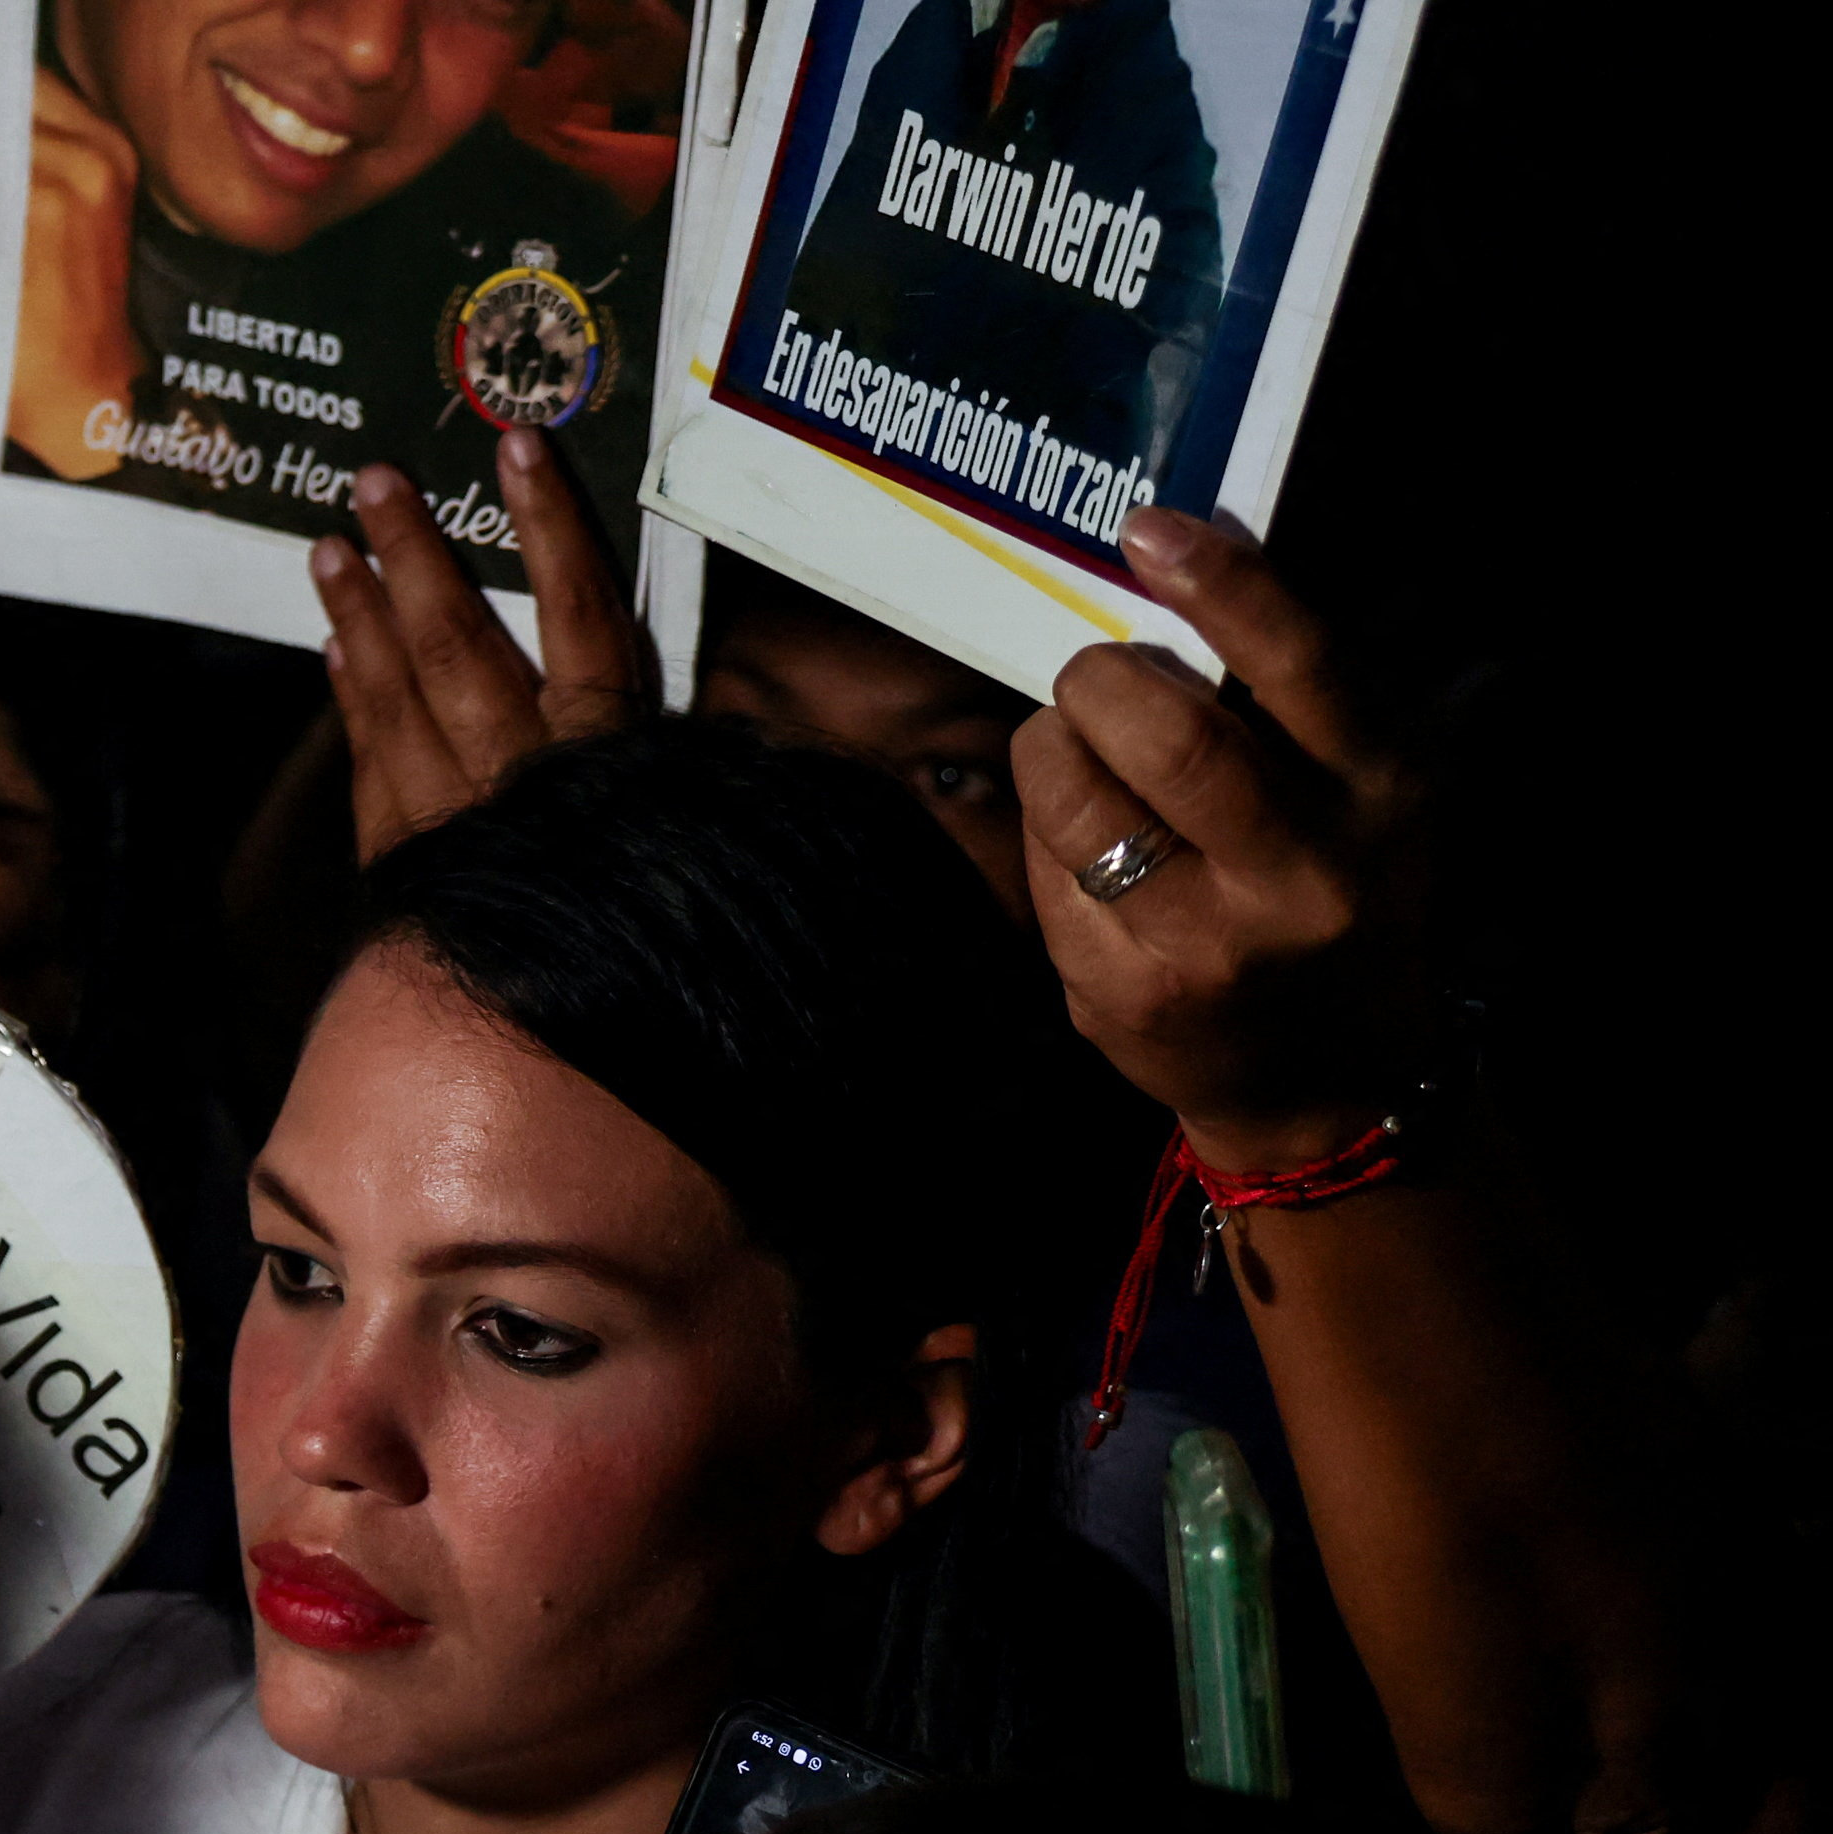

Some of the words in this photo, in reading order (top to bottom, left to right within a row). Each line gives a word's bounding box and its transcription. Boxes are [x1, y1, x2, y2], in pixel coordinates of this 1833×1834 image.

[877, 107, 1036, 264] Darwin
[1022, 159, 1162, 310] Herde
[185, 301, 345, 368] LIBERTAD
[159, 352, 248, 406] PARA
[252, 377, 364, 432] TODOS
[762, 307, 814, 403] En
[803, 326, 1024, 496] desaparición
[81, 398, 263, 492] Gustavo
[751, 1730, 774, 1749] 6:52
